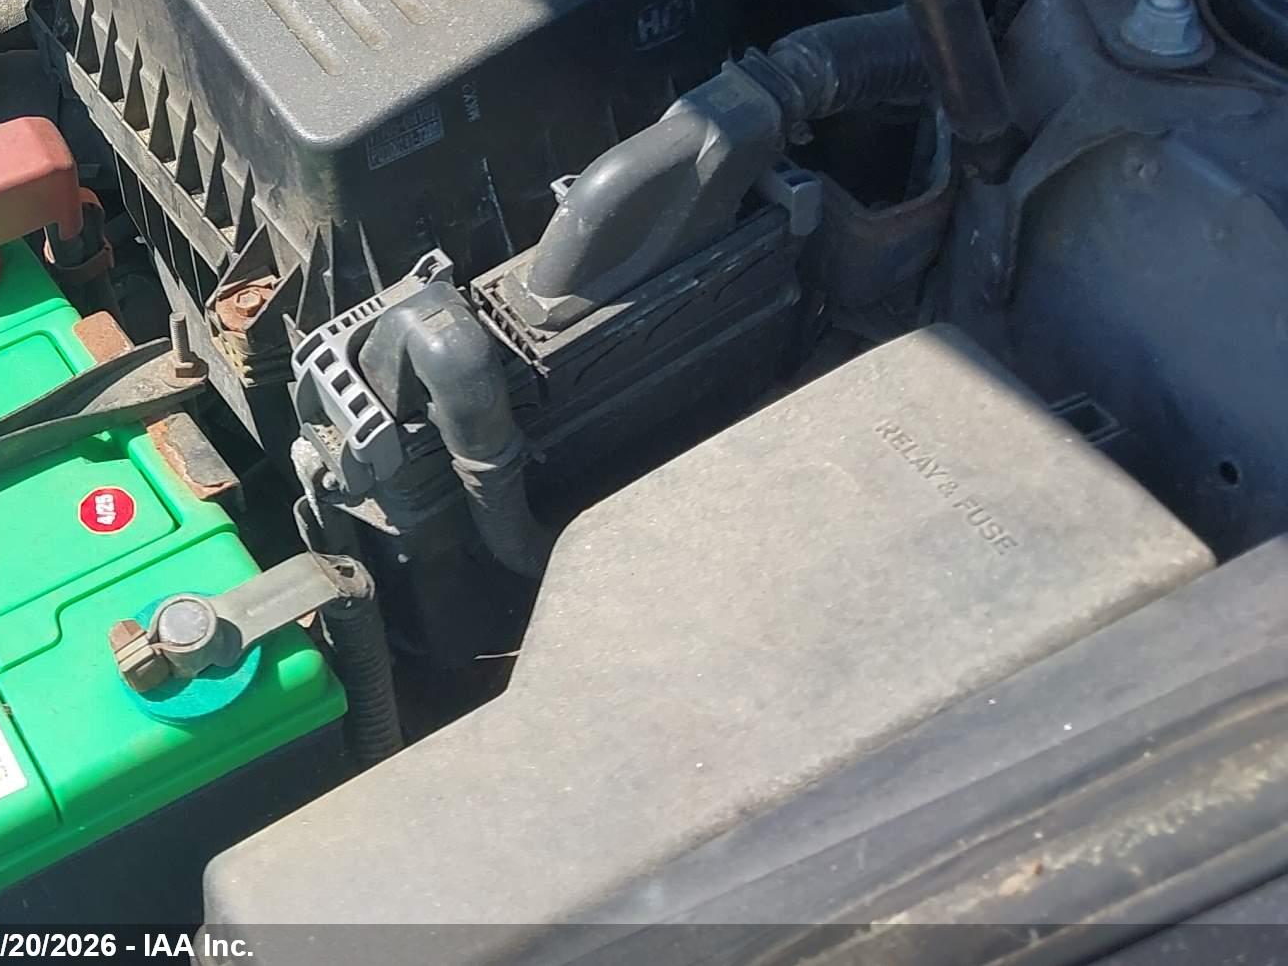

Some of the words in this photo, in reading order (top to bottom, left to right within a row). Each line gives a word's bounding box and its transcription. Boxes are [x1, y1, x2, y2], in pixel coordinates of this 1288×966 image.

[875, 420, 949, 480] RELAY
[937, 481, 959, 498] &
[952, 498, 1019, 556] FUSE
